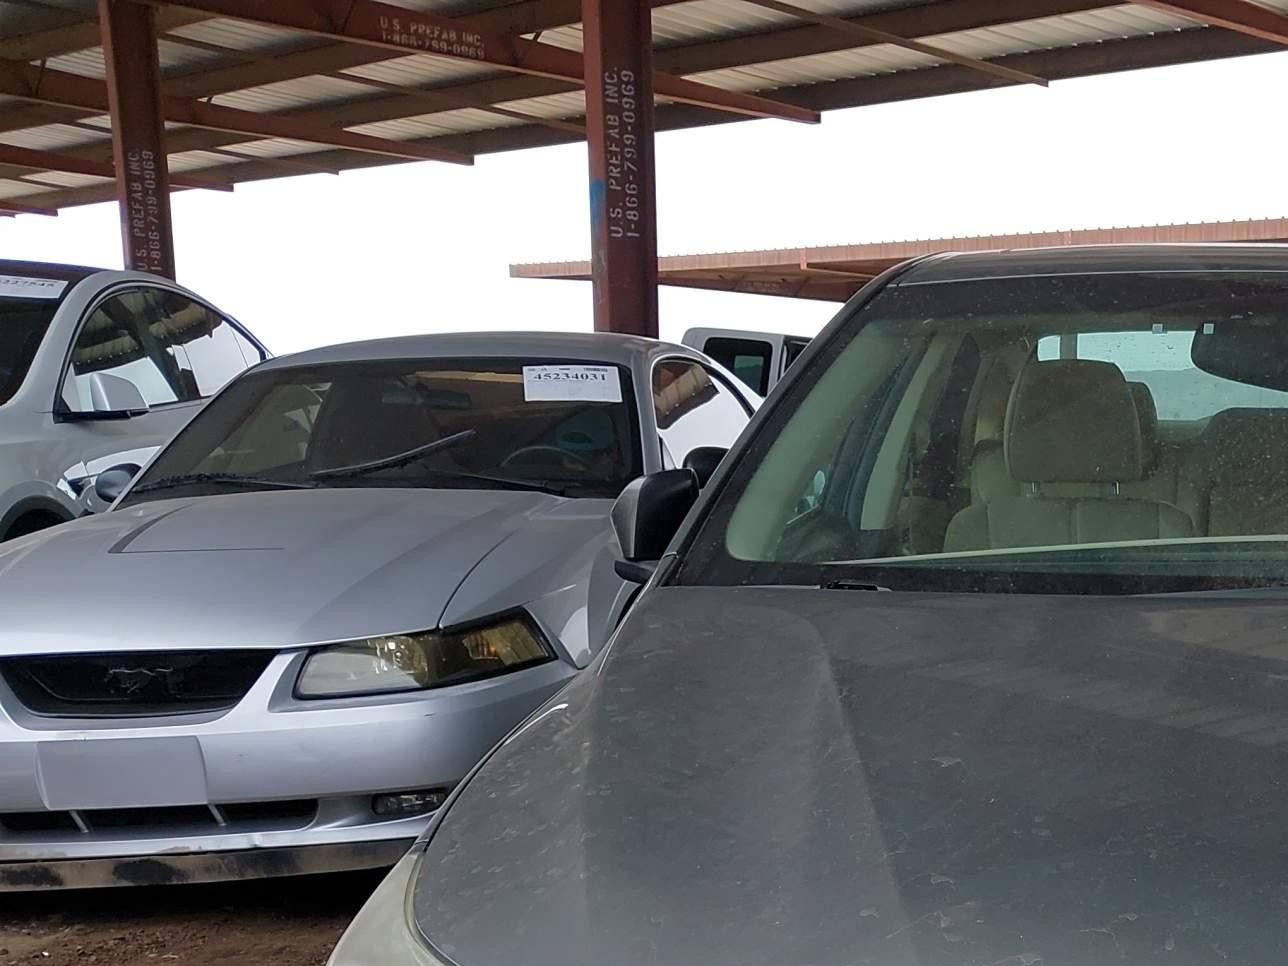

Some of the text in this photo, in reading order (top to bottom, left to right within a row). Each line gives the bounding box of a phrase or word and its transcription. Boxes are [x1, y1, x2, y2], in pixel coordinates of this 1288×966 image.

[604, 66, 624, 238] U.S. PREFAB INC.
[620, 69, 640, 238] 1-866-799-0969
[130, 182, 146, 237] PREFAB
[533, 372, 607, 382] 45234031
